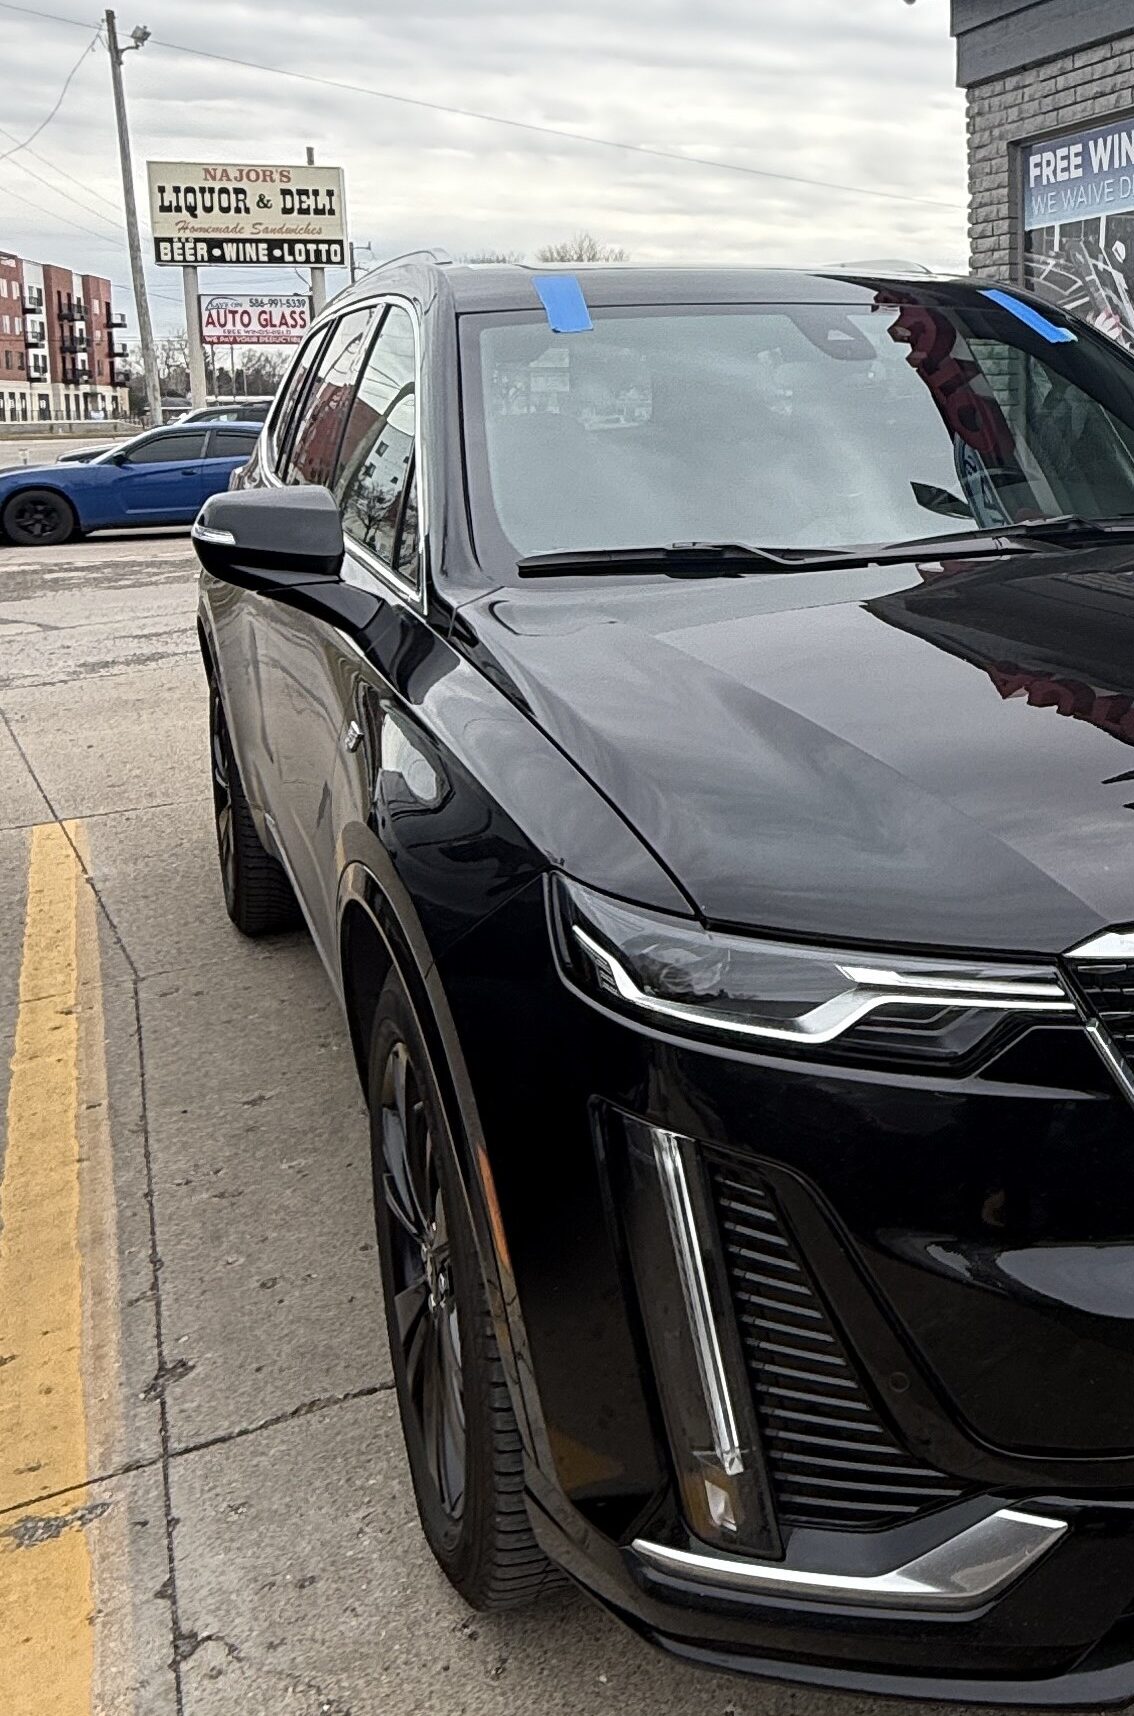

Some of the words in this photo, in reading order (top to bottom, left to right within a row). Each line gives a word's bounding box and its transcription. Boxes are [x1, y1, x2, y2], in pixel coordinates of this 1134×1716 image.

[203, 167, 292, 183] NAJOR'S
[1029, 143, 1083, 188] FREE
[157, 185, 250, 219] LIQUOR
[256, 193, 273, 209] &
[280, 188, 336, 216] DELI
[1032, 193, 1057, 216] WE
[1060, 179, 1115, 209] WAIVE
[175, 220, 244, 235] Homemade
[250, 222, 323, 236] Sandwiches
[159, 241, 208, 262] BEER
[222, 242, 269, 263] WINE
[283, 243, 342, 263] LOTTO
[205, 309, 251, 328] AUTO
[258, 310, 307, 329] GLASS
